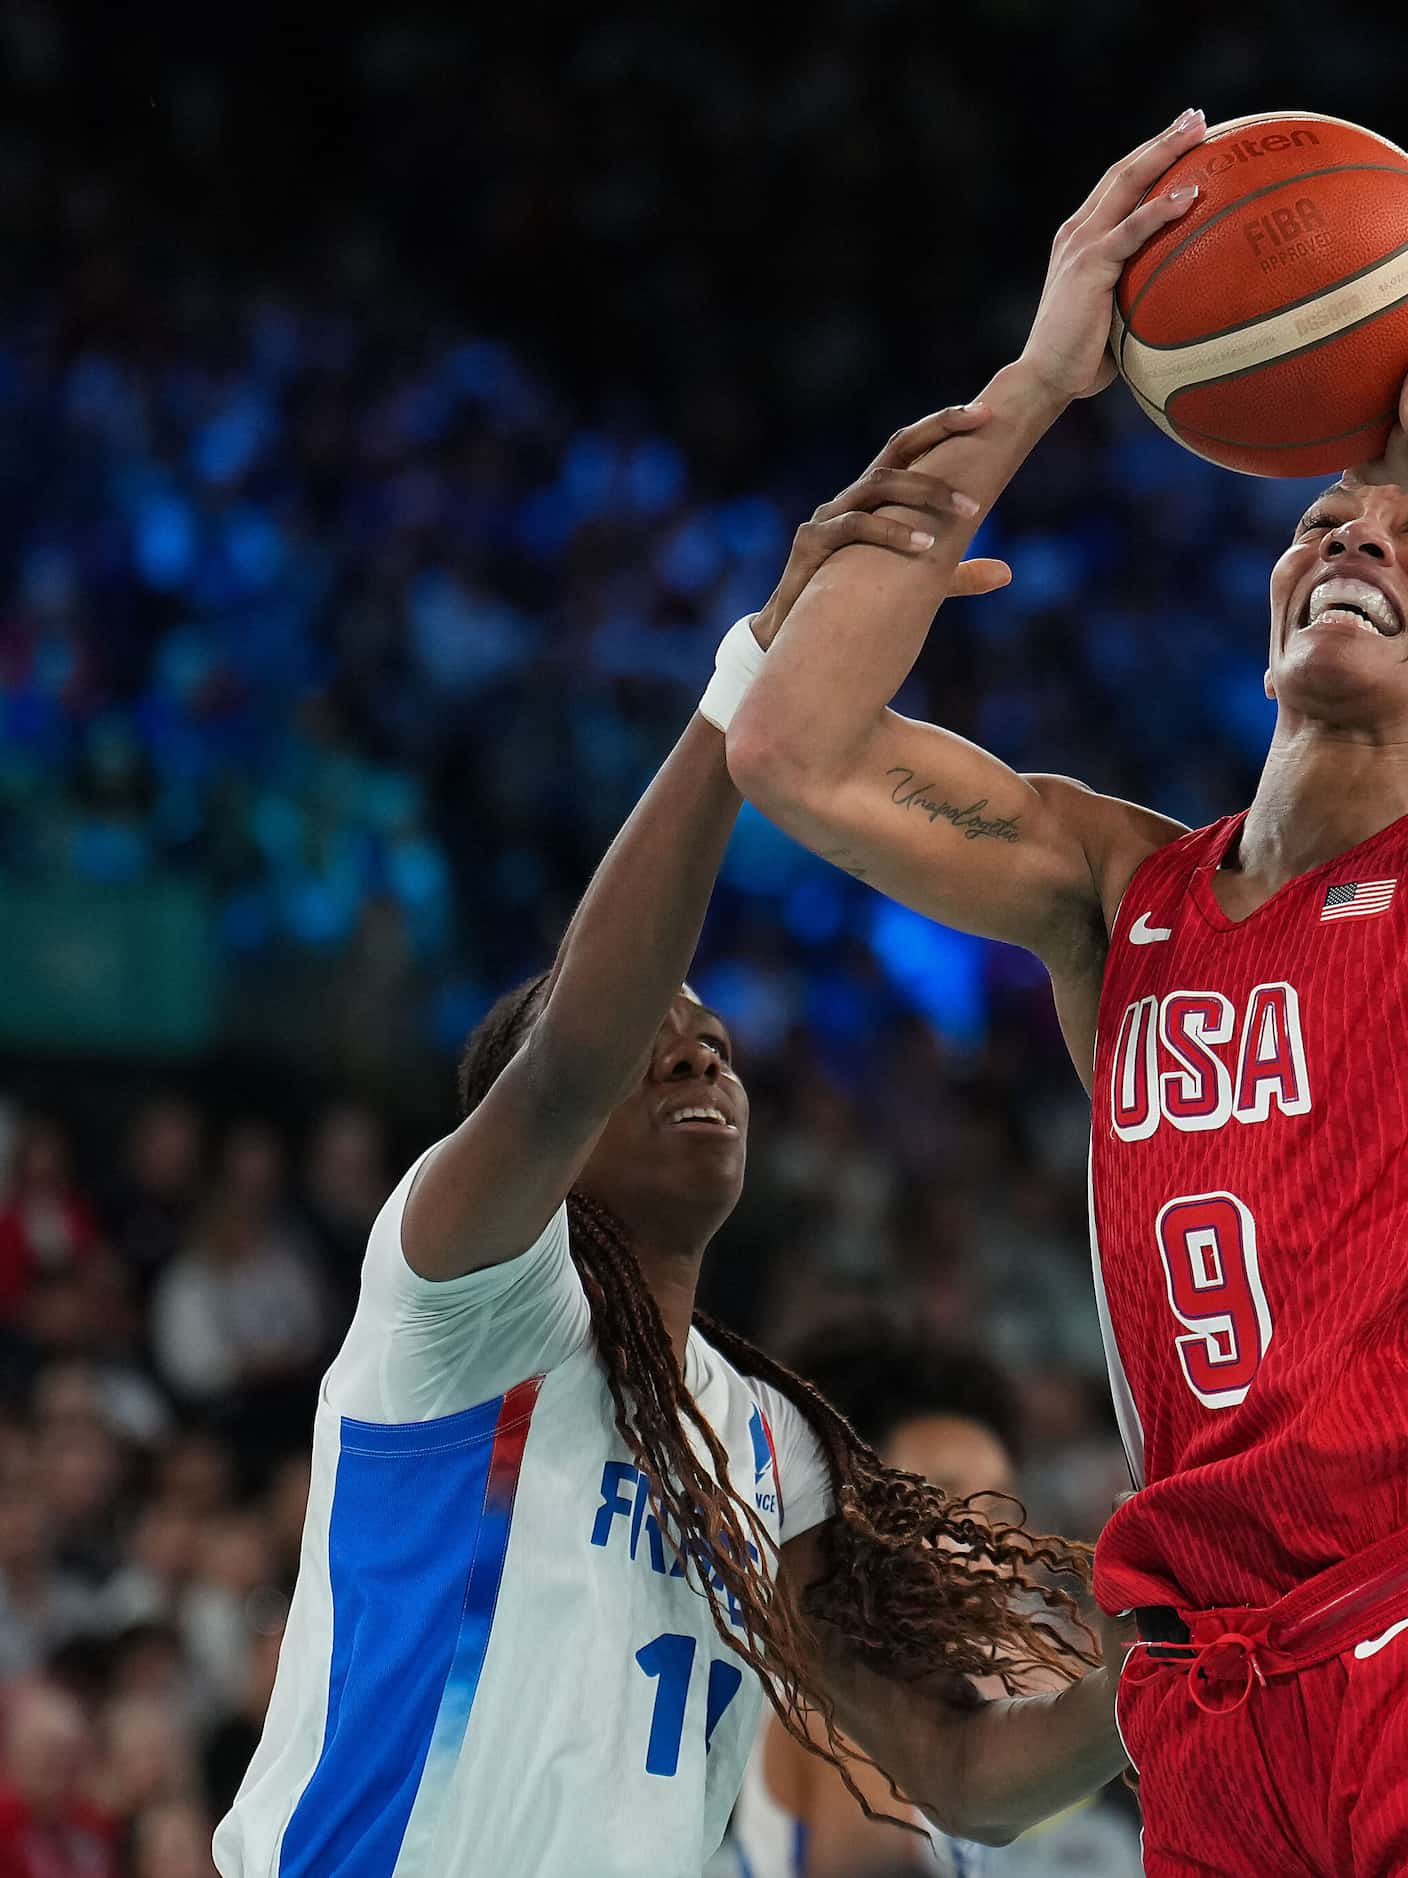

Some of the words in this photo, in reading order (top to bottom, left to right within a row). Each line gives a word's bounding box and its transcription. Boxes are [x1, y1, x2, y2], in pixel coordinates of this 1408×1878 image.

[1246, 198, 1326, 257] FIBA
[1260, 231, 1333, 274] APPROVED
[1112, 981, 1312, 1143] USA
[1155, 1190, 1273, 1410] 9
